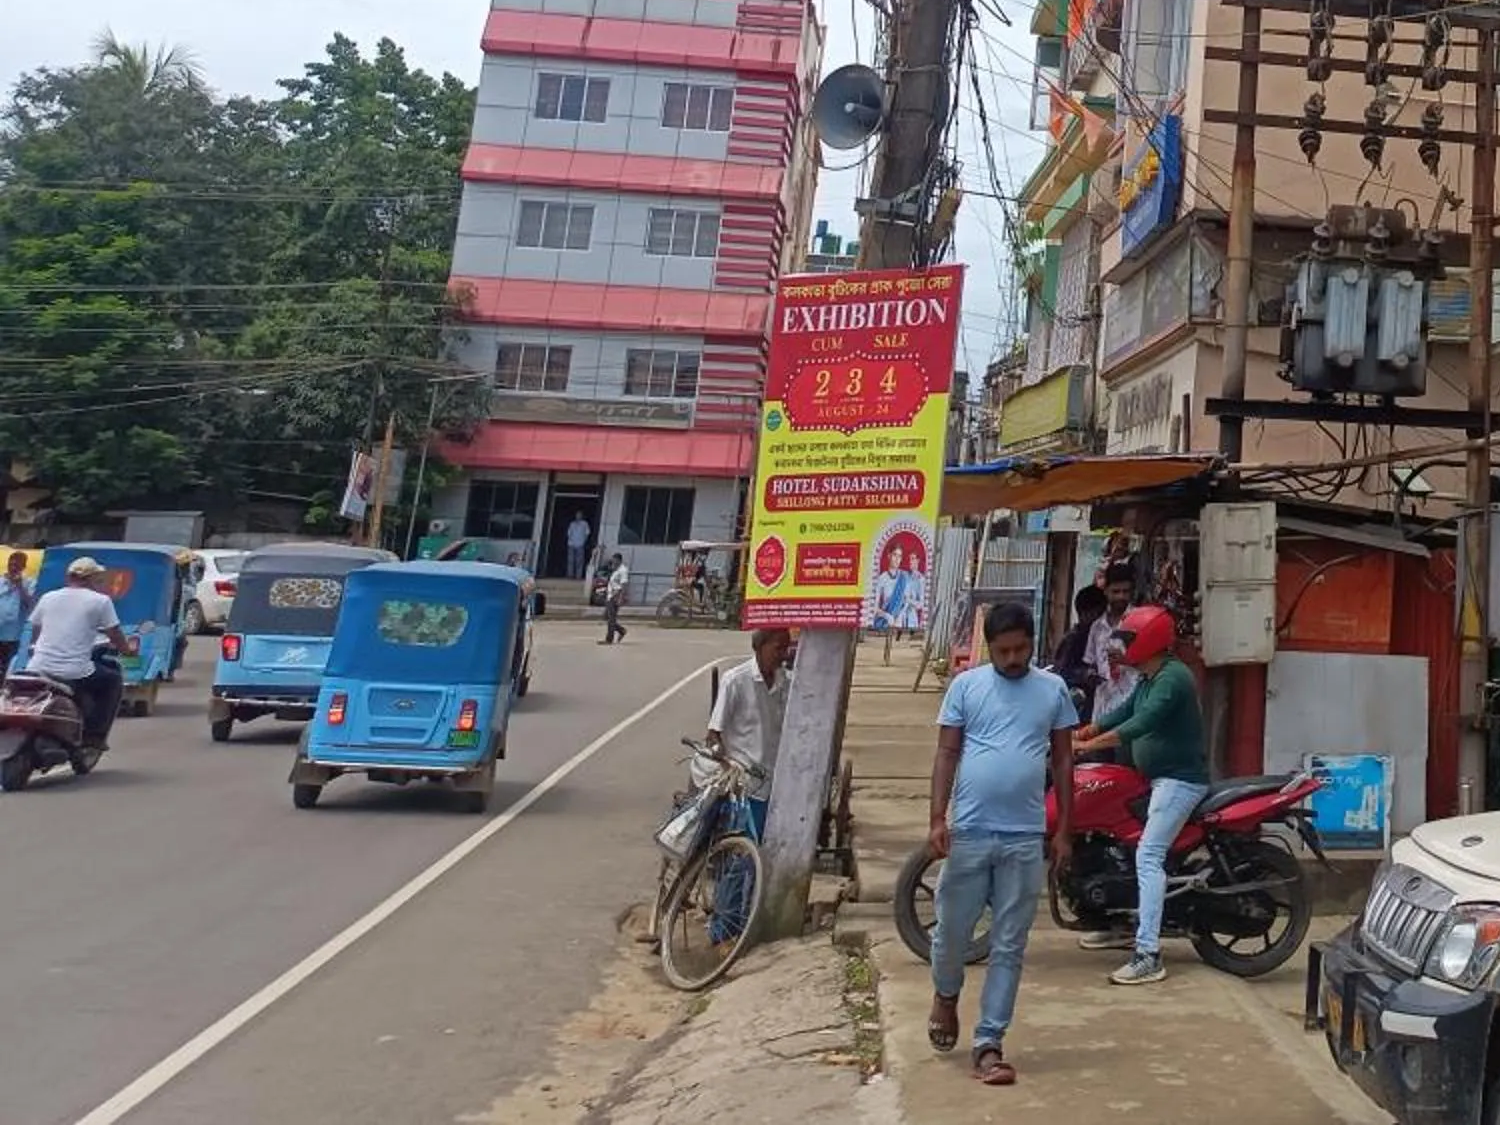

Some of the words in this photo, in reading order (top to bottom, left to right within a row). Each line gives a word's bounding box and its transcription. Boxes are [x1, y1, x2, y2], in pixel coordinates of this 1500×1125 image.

[780, 297, 949, 334] EXHIBITION
[811, 336, 843, 352] CUM
[873, 332, 909, 348] SALE
[814, 369, 831, 397] 2
[845, 367, 863, 395] 3
[879, 364, 897, 394] 4
[817, 404, 865, 418] AUGUST
[772, 478, 819, 495] HOTEL
[821, 474, 918, 493] SUDAKSHINA
